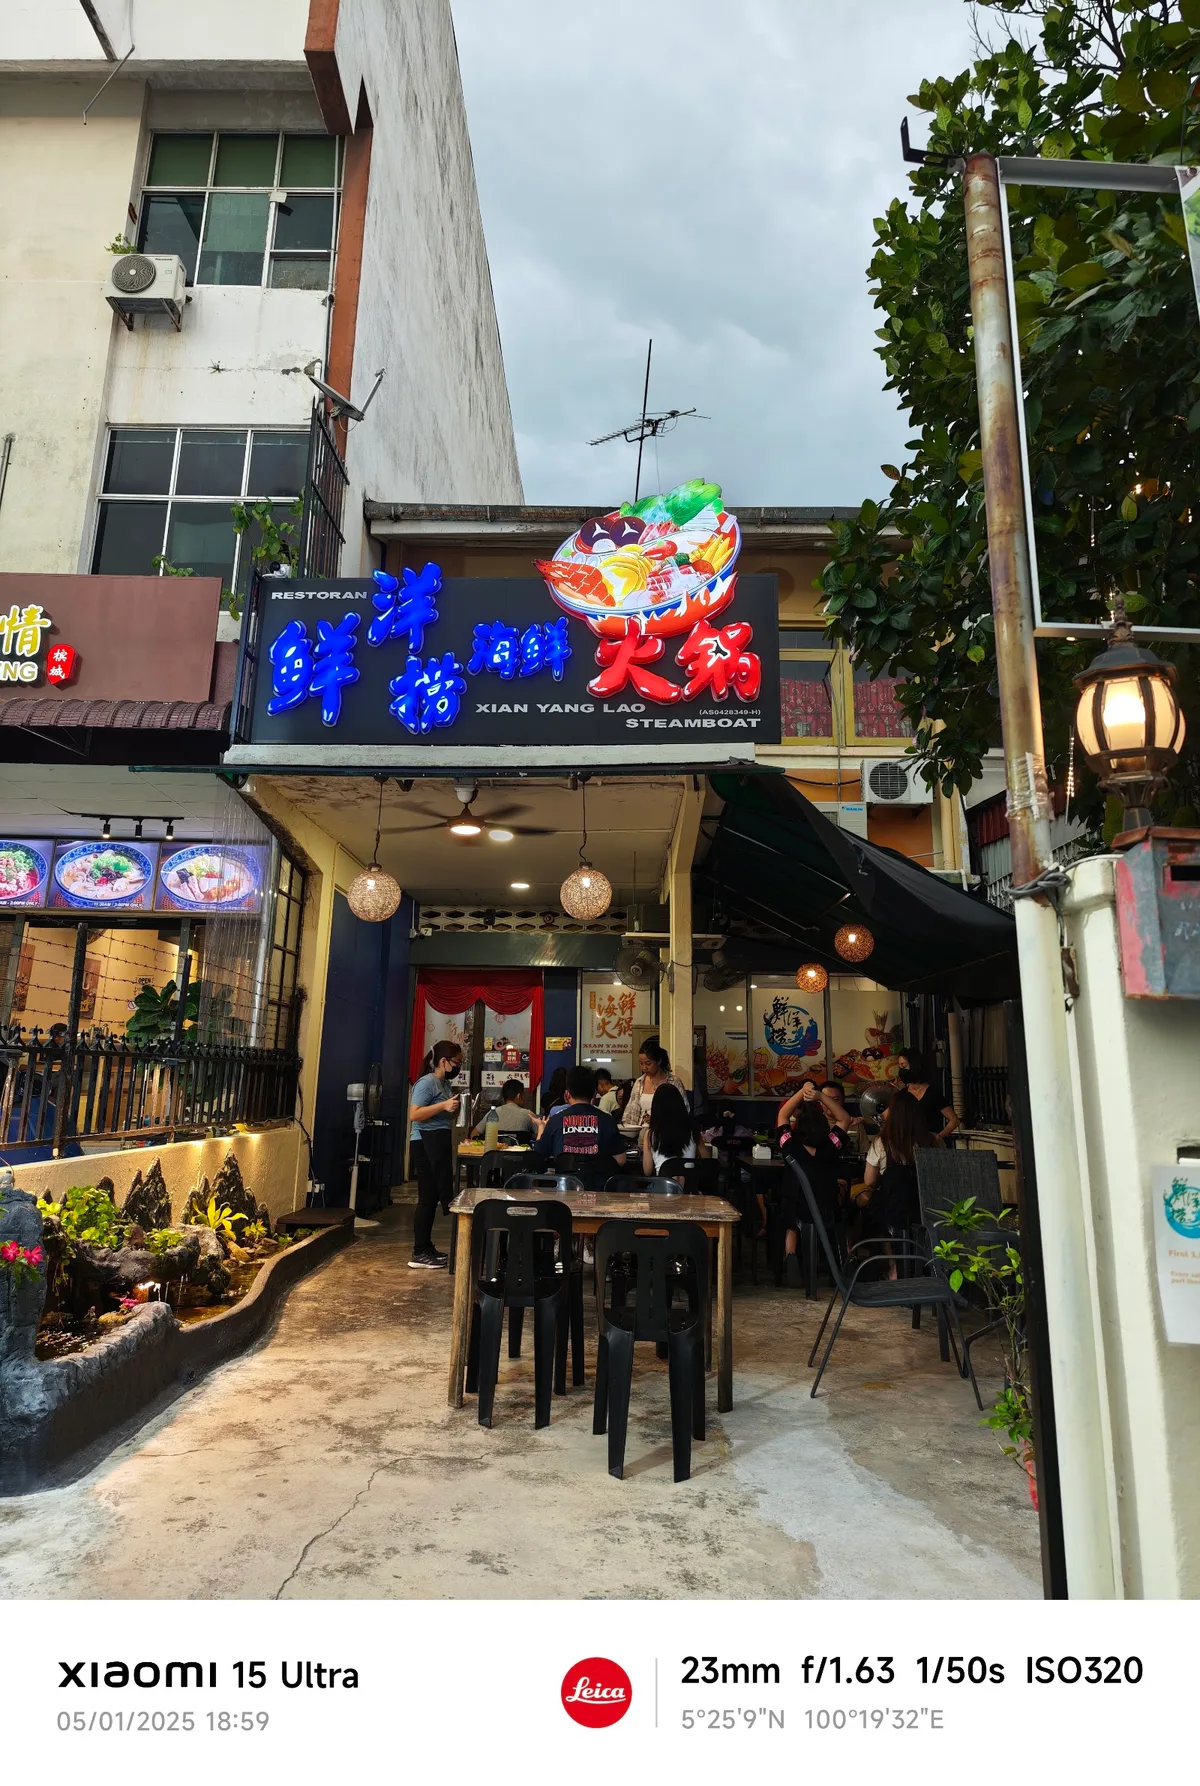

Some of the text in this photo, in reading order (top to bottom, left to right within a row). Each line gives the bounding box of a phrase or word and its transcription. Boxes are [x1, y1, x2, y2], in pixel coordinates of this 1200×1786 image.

[271, 591, 368, 600] RESTORAN
[586, 615, 762, 704] 火锅
[475, 703, 646, 713] XIAN YANG LAO
[625, 717, 761, 728] STEAMBOAT
[563, 1115, 598, 1127] NORTH
[563, 1126, 598, 1134] LONDON
